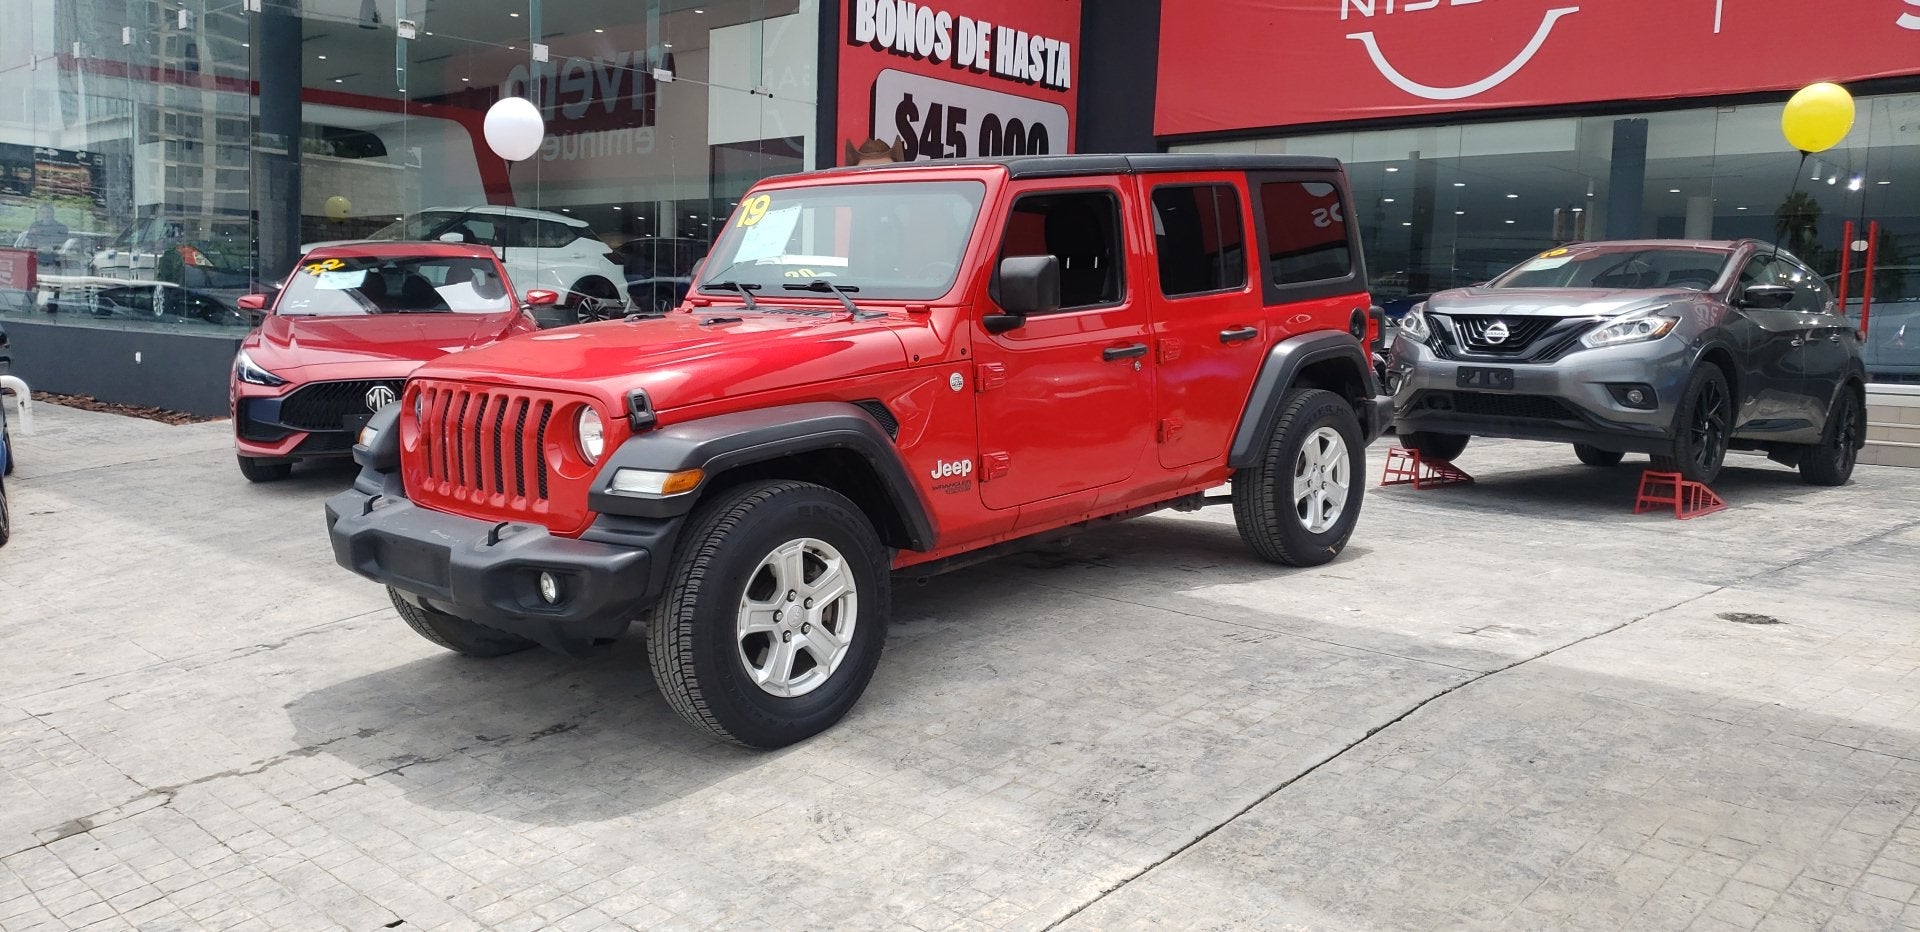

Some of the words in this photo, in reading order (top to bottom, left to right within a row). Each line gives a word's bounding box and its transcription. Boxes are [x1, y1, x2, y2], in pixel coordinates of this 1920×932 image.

[855, 0, 952, 61] BONOS
[957, 15, 991, 71] DE
[995, 25, 1071, 88] HASTA
[736, 194, 771, 228] 19
[304, 258, 345, 276] 22
[368, 388, 393, 412] MG
[930, 459, 972, 479] Jeep
